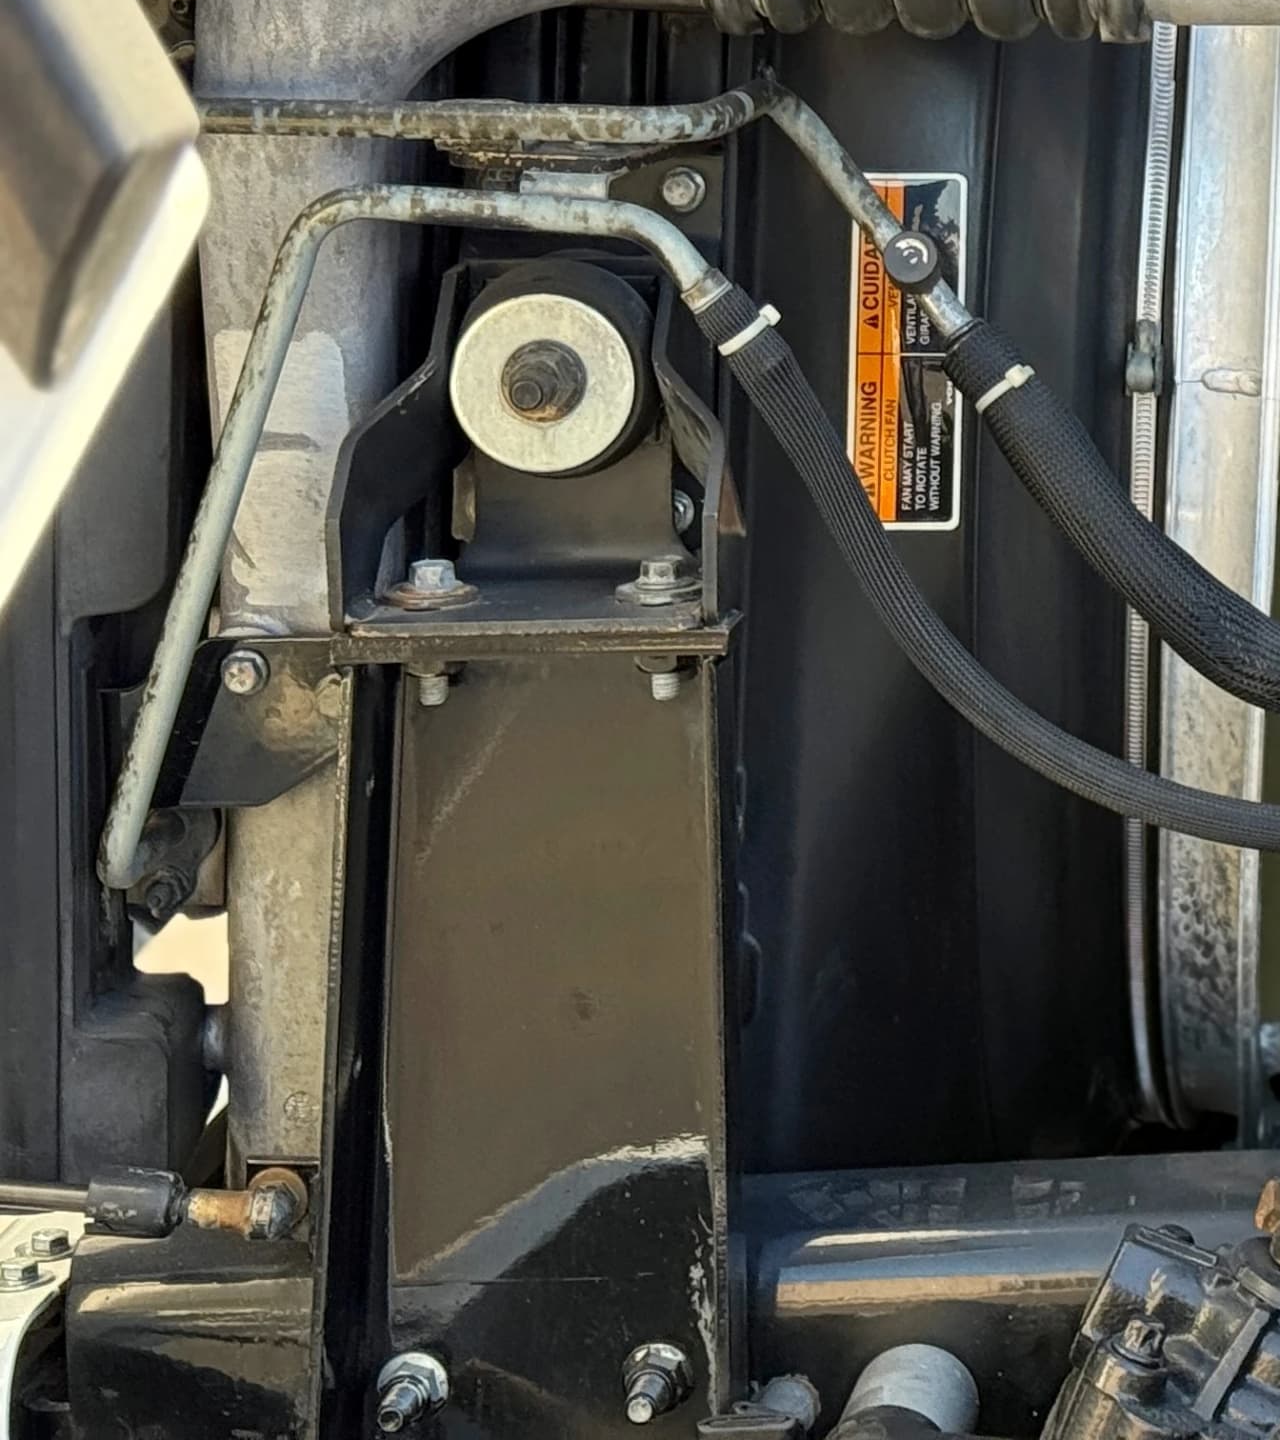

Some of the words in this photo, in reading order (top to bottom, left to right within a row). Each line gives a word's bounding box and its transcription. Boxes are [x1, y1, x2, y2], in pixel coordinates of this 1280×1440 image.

[862, 239, 880, 311] CUIDA
[859, 381, 878, 480] WARNING
[885, 399, 897, 426] FAN
[883, 428, 896, 482] CLUTCH
[903, 421, 915, 459] START
[901, 460, 913, 491] MAY
[916, 447, 927, 493] ROTATE
[929, 459, 941, 512] WITHOUT
[901, 491, 913, 511] FAN
[915, 494, 927, 511] TO
